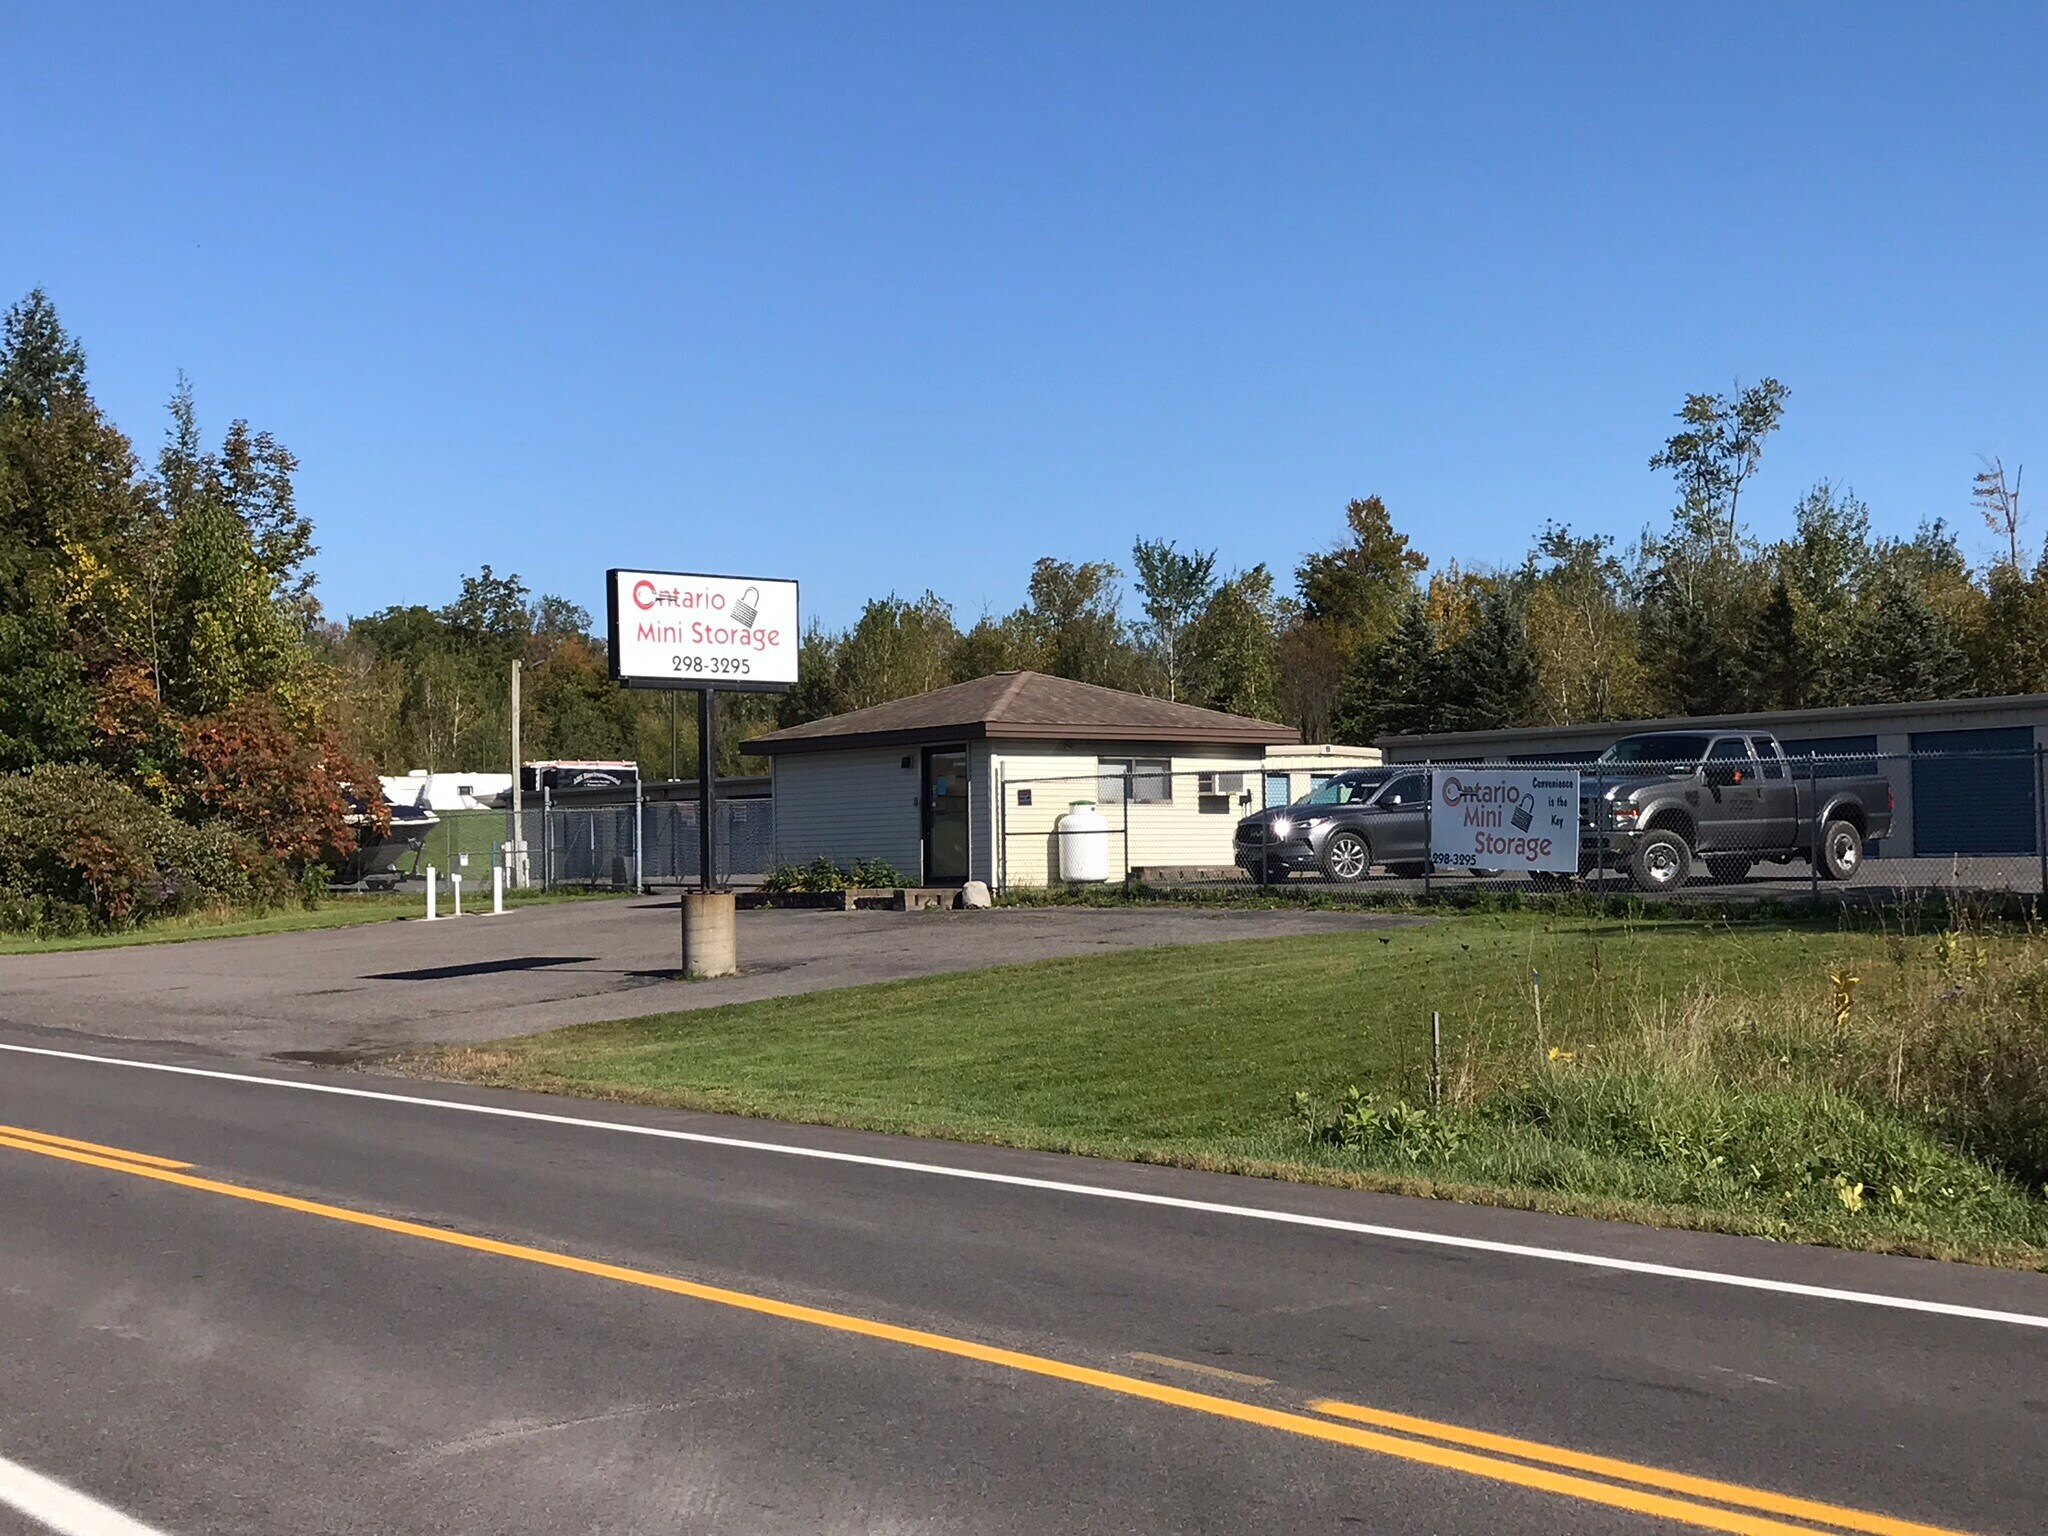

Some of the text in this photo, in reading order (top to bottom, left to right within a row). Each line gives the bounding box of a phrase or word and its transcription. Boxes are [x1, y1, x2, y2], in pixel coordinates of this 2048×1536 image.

[633, 580, 725, 610] Ontario
[637, 621, 780, 651] Mini Storage
[672, 656, 750, 674] 298-3295
[1442, 777, 1520, 807] Ontario
[1532, 777, 1574, 789] Convenience
[1548, 796, 1568, 808] is the
[1463, 805, 1502, 827] Mini
[1551, 815, 1564, 829] Key
[1475, 831, 1552, 862] Storage
[1432, 853, 1477, 866] 298-3295
